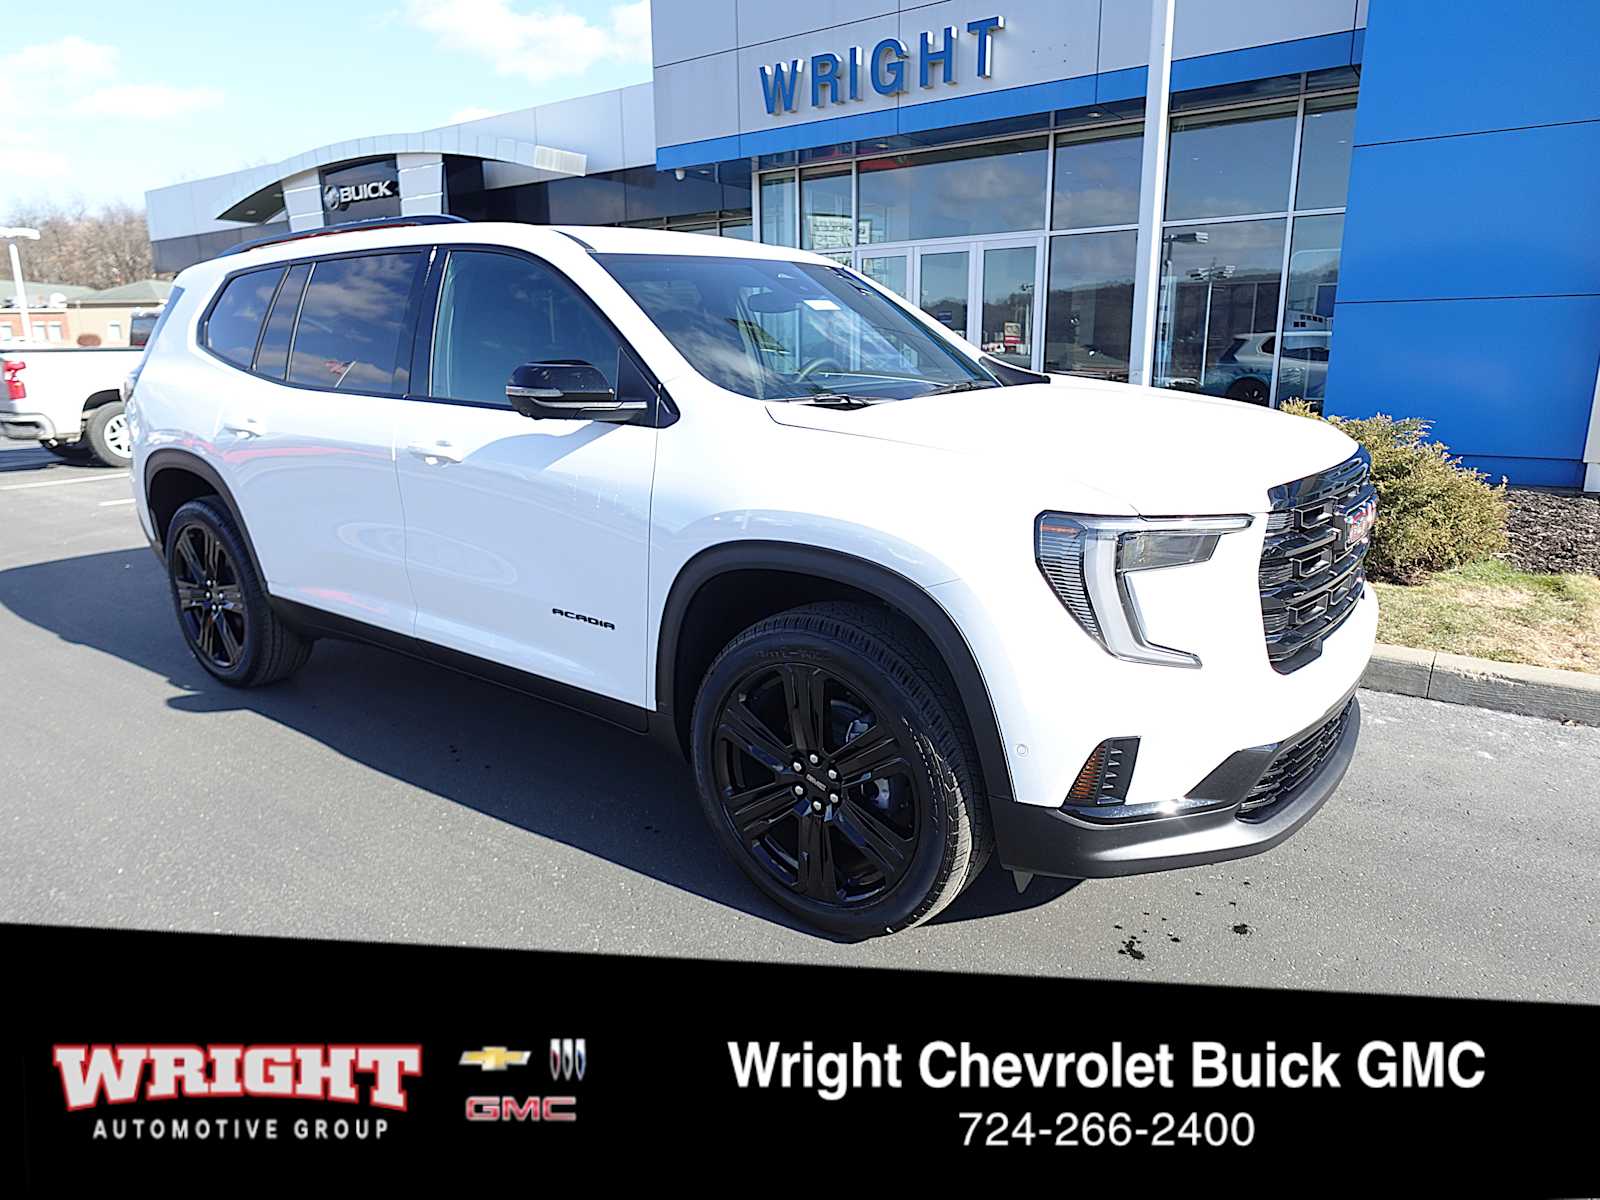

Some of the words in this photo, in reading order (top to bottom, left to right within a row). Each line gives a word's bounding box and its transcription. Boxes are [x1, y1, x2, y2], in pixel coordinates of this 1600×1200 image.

[759, 16, 1005, 115] WRIGHT
[340, 180, 393, 203] BUICK
[552, 608, 616, 631] ACADIA
